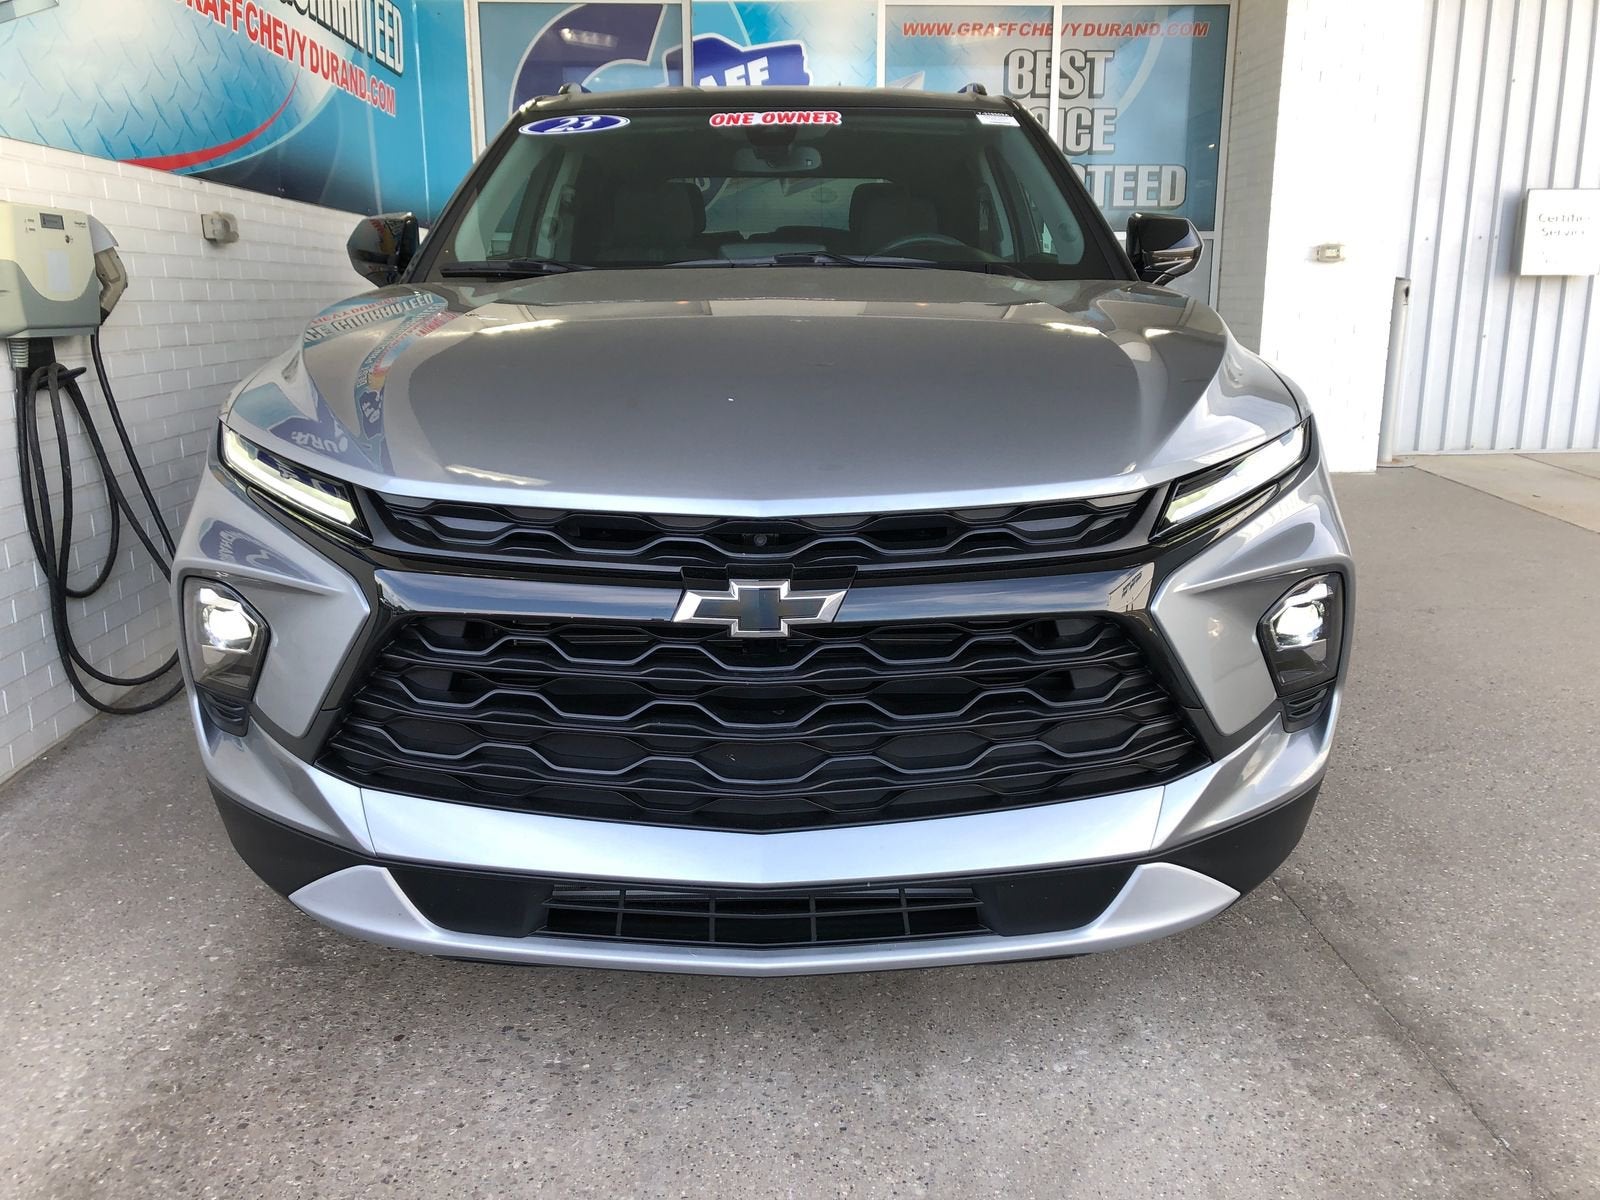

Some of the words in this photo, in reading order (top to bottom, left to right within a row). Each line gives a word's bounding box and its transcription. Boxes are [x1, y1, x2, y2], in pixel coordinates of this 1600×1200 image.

[1004, 49, 1114, 99] BEST
[543, 115, 601, 133] 23
[710, 112, 755, 127] ONE
[761, 110, 840, 125] OWNER
